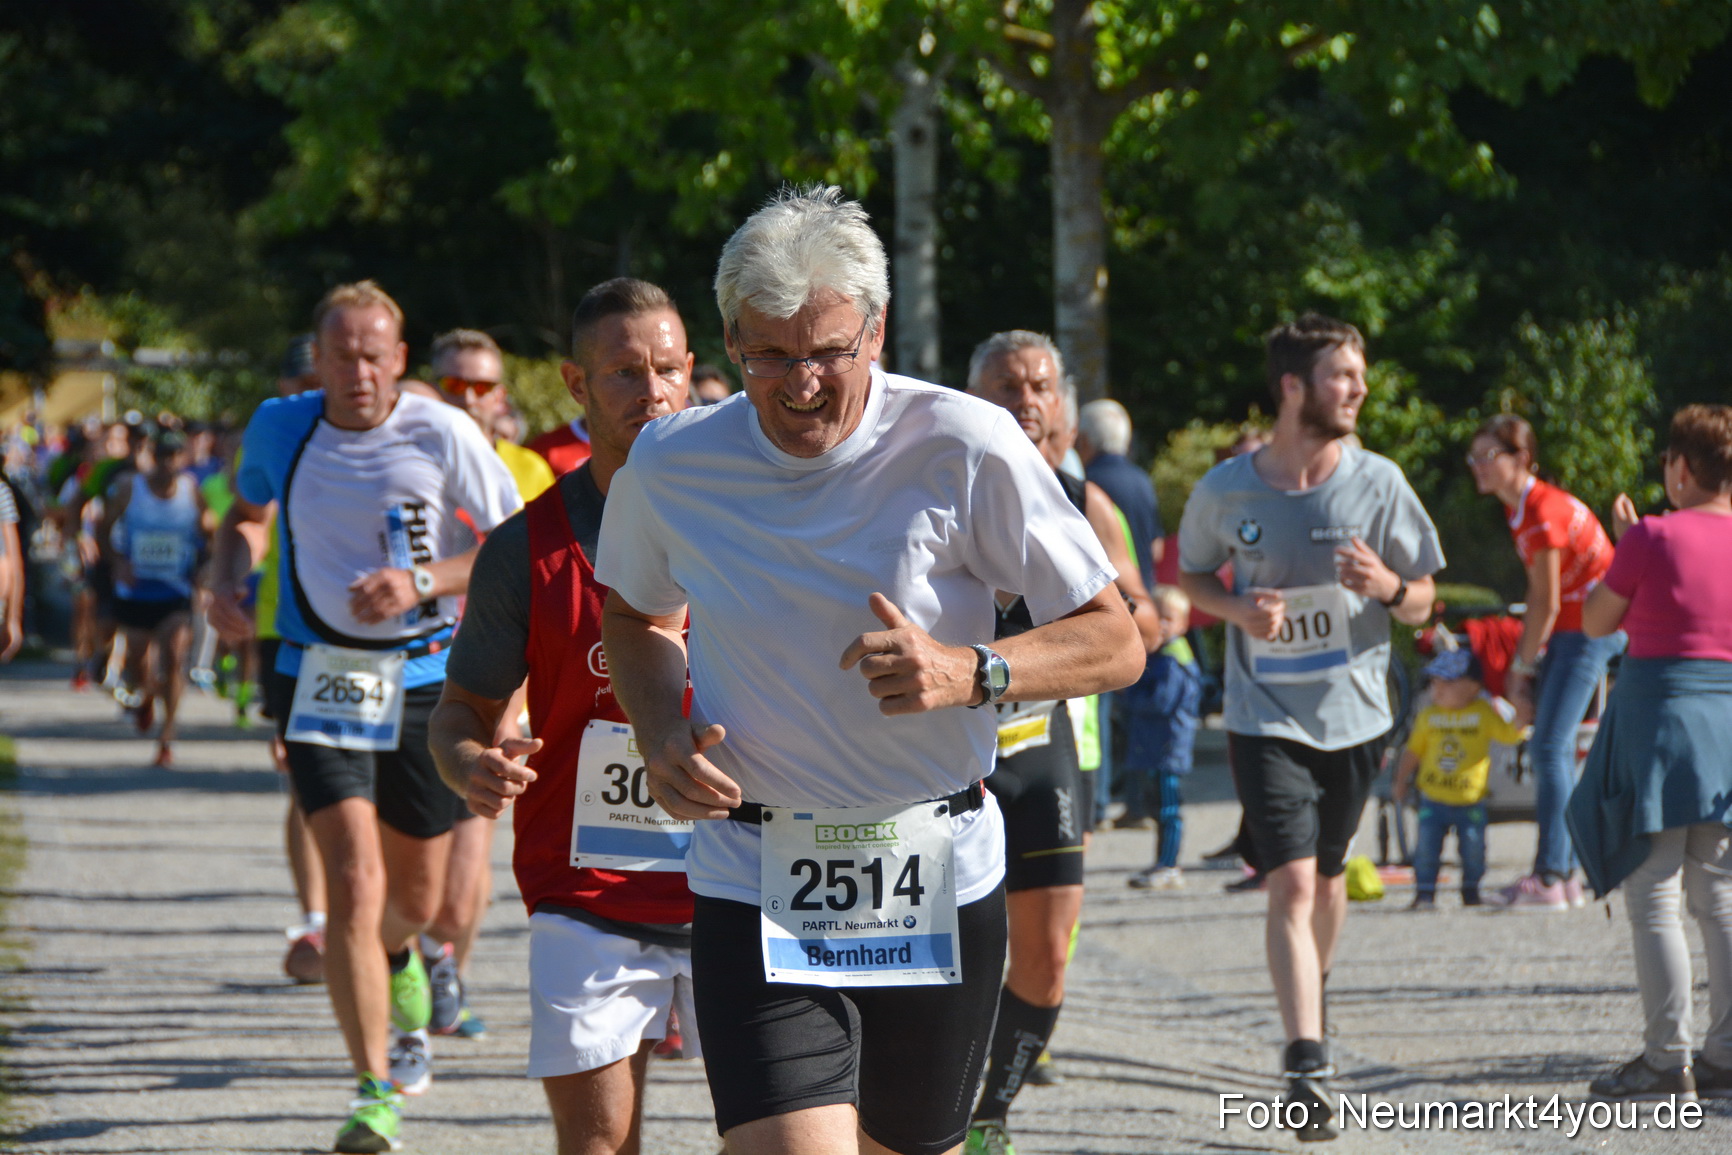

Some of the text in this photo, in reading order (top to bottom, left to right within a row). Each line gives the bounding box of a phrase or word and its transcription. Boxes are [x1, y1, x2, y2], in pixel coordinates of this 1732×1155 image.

[1266, 610, 1331, 643] 010
[313, 673, 384, 707] 2654
[601, 763, 656, 809] 30
[609, 812, 690, 826] PARTL Neumarkt
[815, 822, 899, 842] BOCK
[816, 843, 841, 851] inspired
[872, 840, 900, 848] concepts
[790, 854, 925, 911] 2514
[802, 918, 899, 931] PARTL Neumarkt
[806, 942, 912, 967] Bernhard
